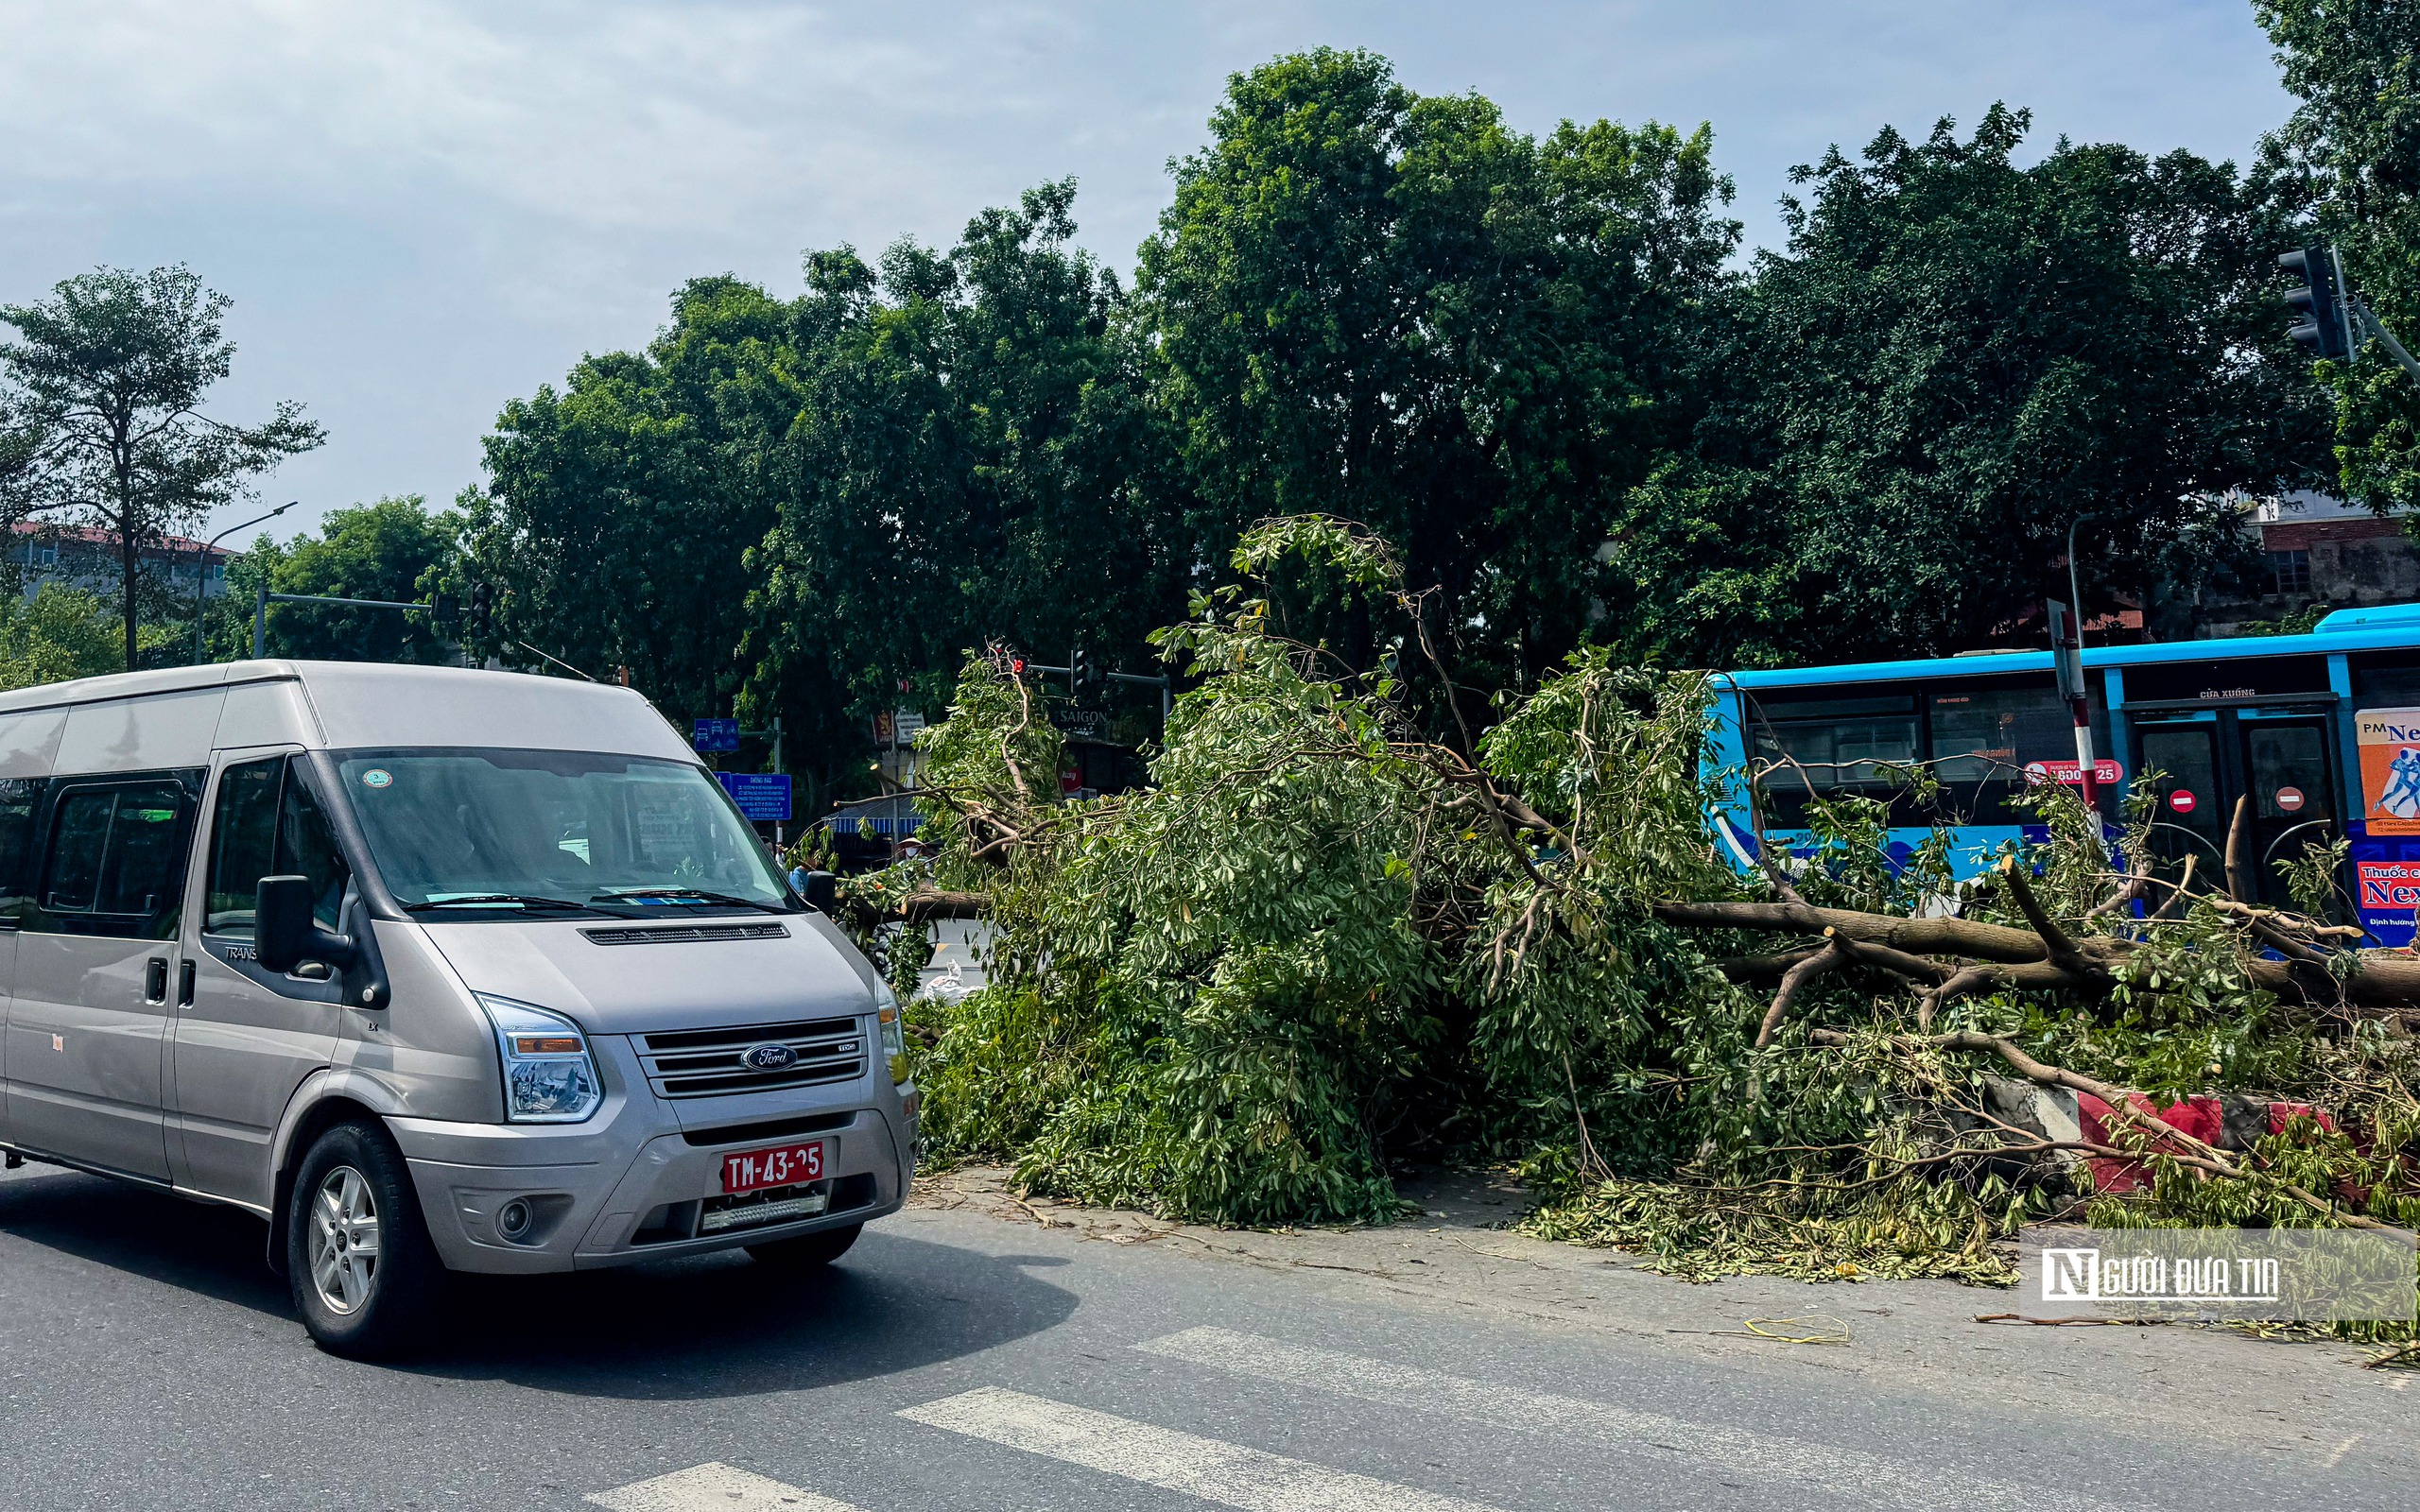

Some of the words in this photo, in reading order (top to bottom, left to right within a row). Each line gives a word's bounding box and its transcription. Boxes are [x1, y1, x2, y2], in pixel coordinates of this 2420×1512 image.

[2363, 723, 2387, 733] PM
[2362, 865, 2408, 878] Thuốc
[2370, 919, 2389, 927] Định
[2390, 919, 2415, 927] hướng
[758, 1048, 787, 1066] Ford
